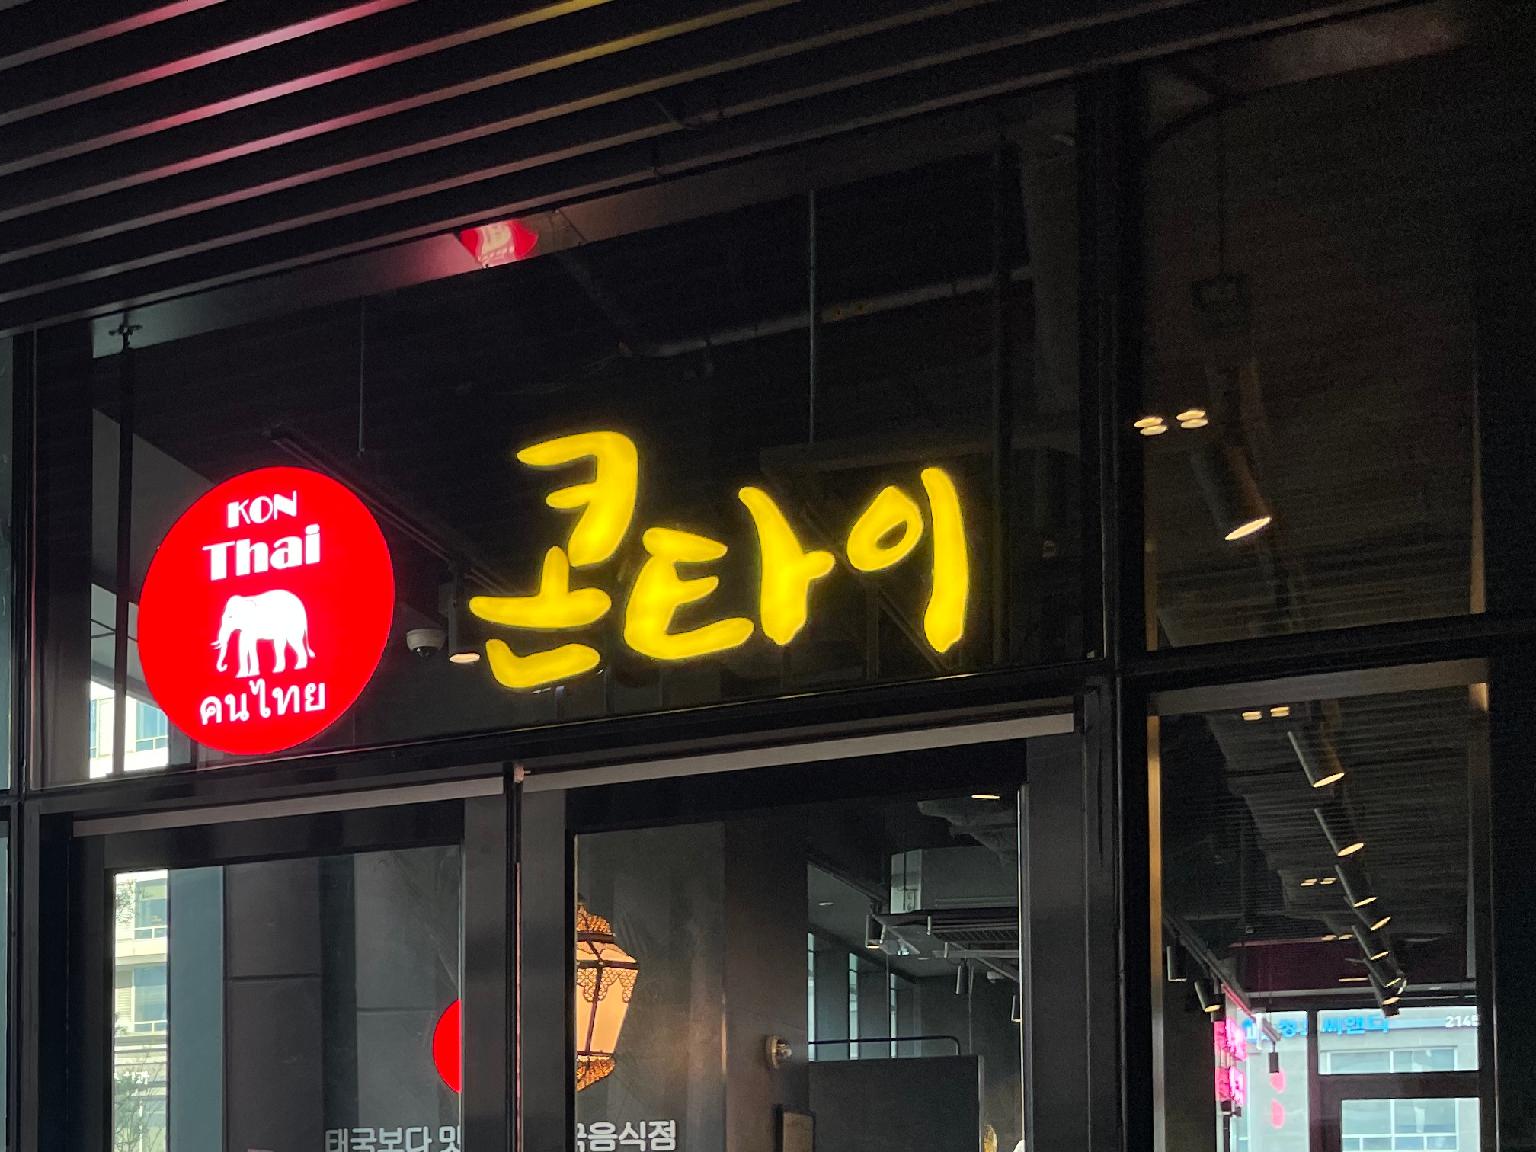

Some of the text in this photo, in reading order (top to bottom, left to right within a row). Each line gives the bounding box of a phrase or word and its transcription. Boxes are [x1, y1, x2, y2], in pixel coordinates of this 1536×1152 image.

[227, 490, 297, 529] KON
[202, 524, 321, 582] Thai
[468, 430, 968, 691] 콘타이
[199, 678, 327, 726] คนไทย
[577, 1119, 676, 1152] 음식점
